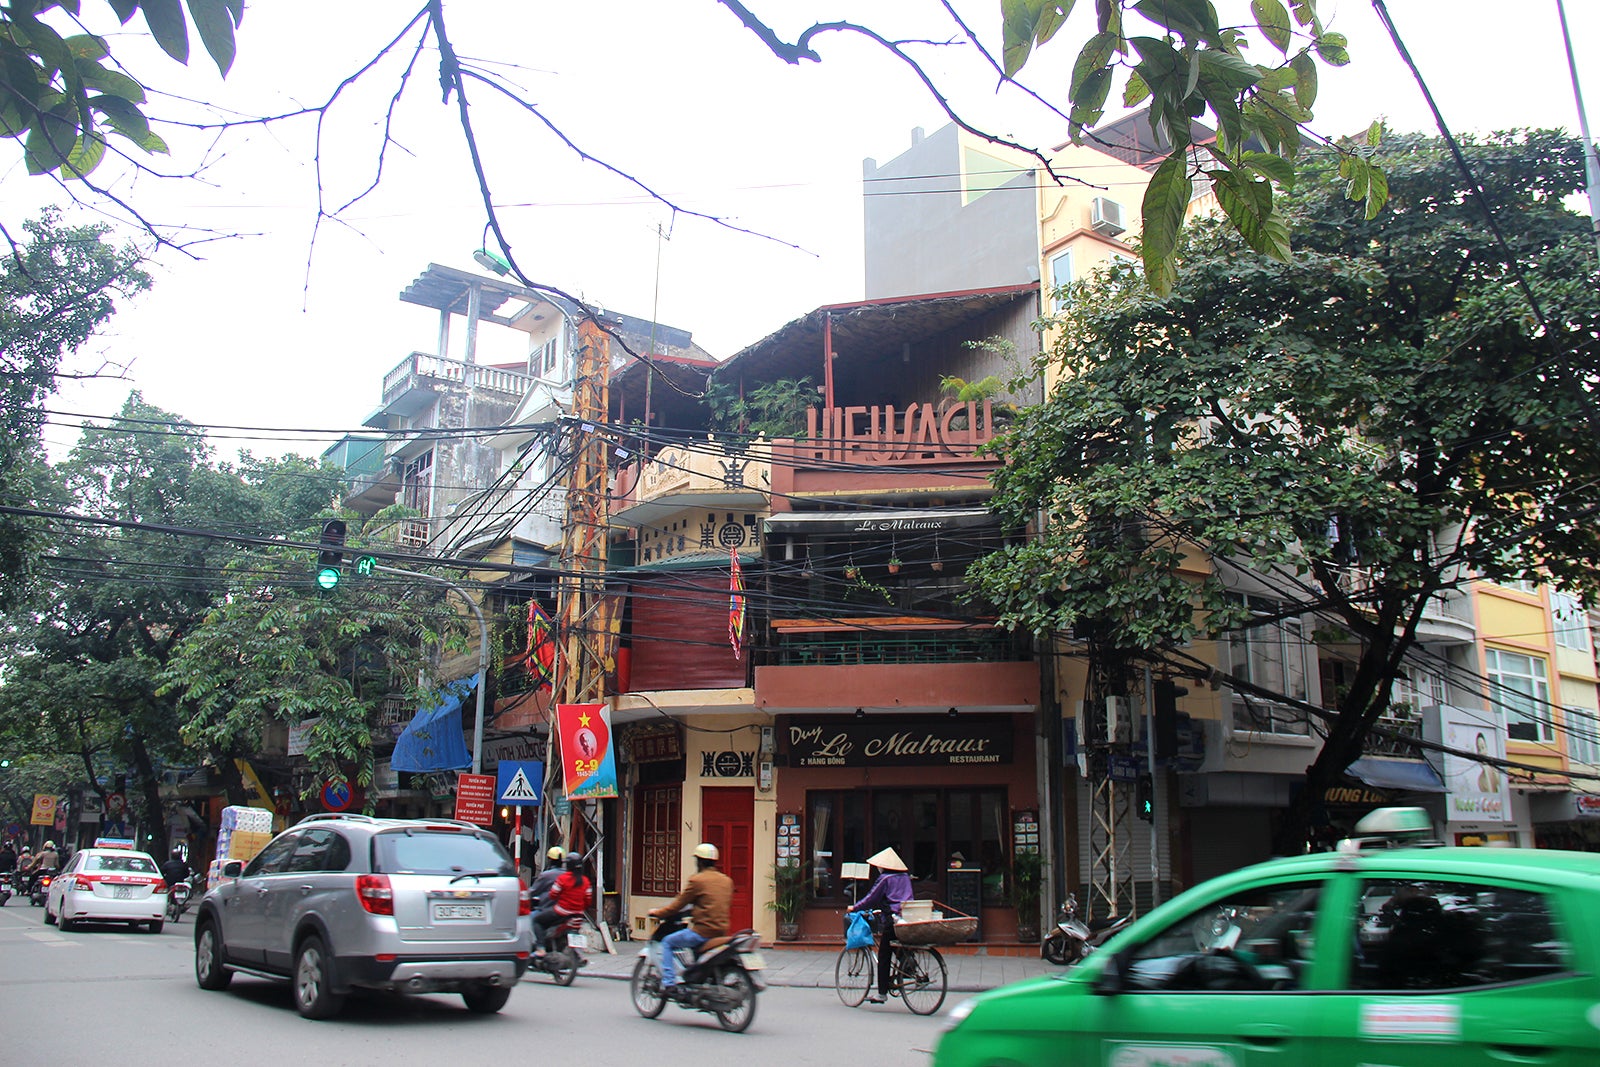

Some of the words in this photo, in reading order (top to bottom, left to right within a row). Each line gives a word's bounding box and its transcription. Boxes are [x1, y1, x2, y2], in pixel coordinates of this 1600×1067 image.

[854, 520, 877, 531] Le
[879, 519, 942, 531] Malraux
[789, 726, 823, 746] Duy
[811, 733, 855, 756] Le
[864, 731, 990, 757] Malraux
[575, 759, 598, 772] 2-9
[800, 758, 806, 766] 2
[949, 755, 1000, 764] RESTAURANT
